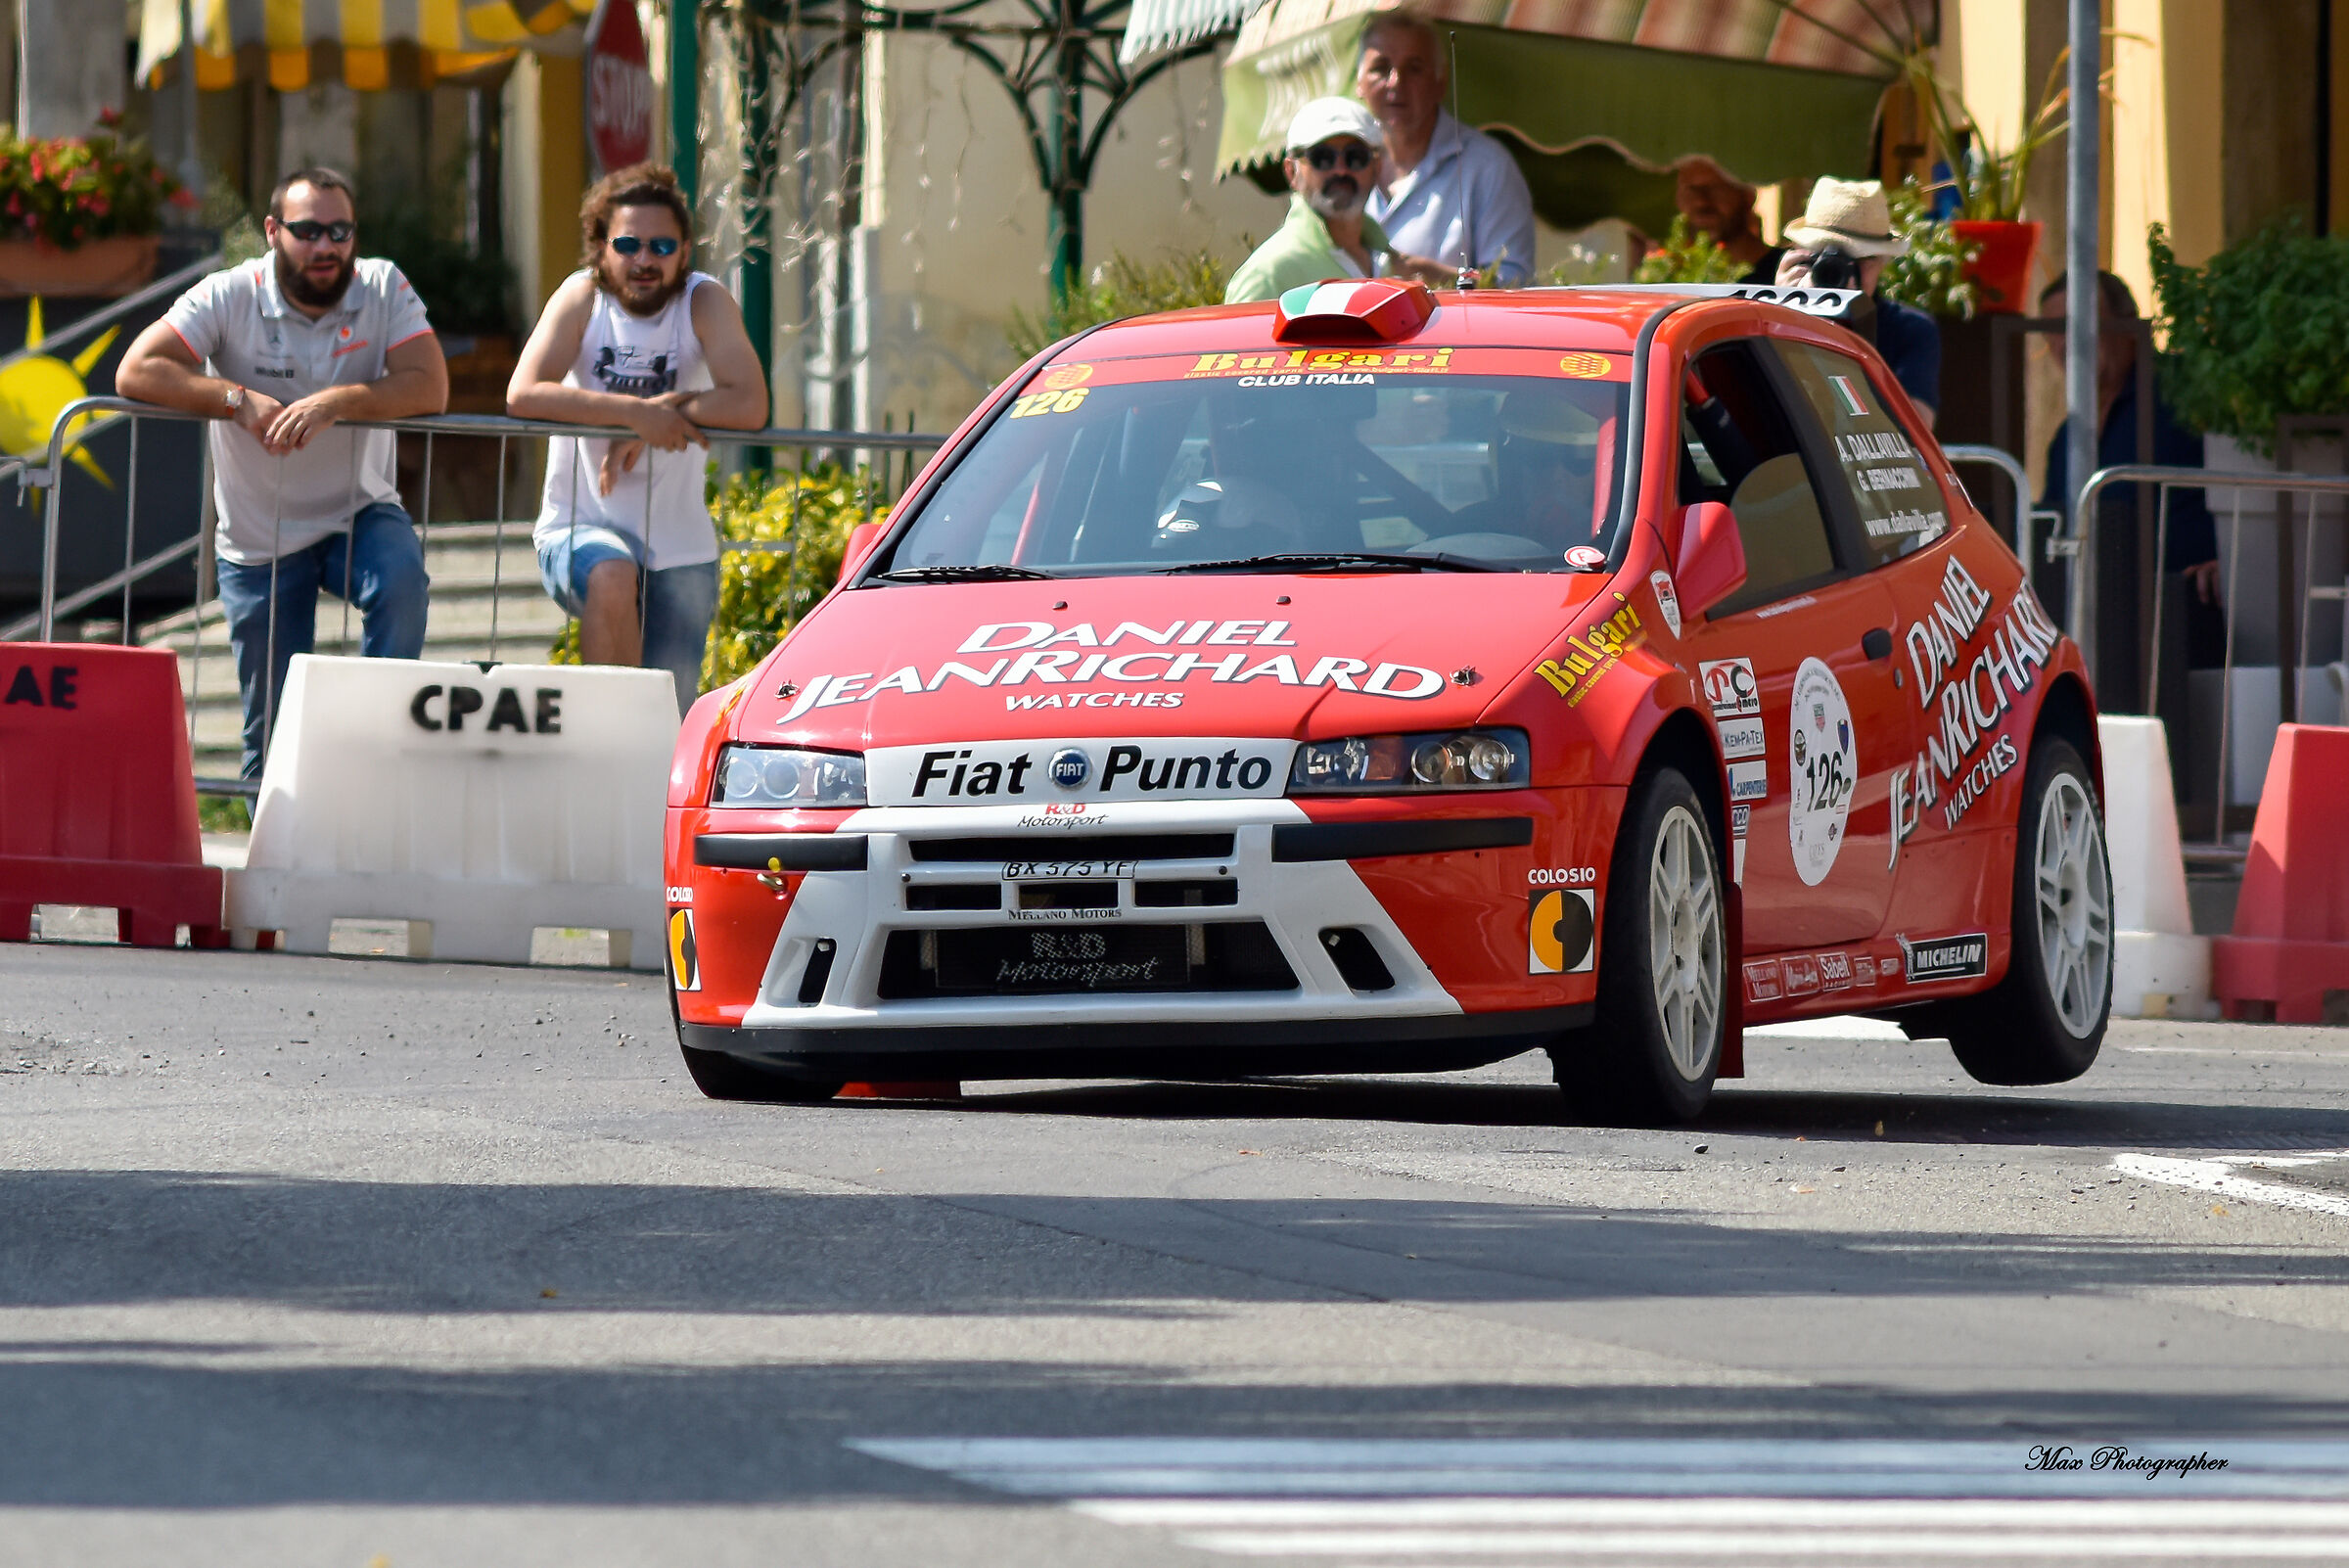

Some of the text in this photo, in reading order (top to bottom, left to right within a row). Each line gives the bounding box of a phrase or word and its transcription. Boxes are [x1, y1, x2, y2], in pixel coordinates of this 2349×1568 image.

[1191, 347, 1453, 370] Bulgari
[1237, 373, 1375, 388] CLUB ITALIA
[1009, 387, 1090, 419] 126
[1834, 435, 1854, 462] A.
[955, 620, 1299, 654] DANIEL
[1533, 591, 1642, 698] Bulgari
[1906, 553, 1993, 711] DANIEL
[0, 665, 78, 712] AE
[775, 650, 1448, 725] JEANRICHARD
[1005, 691, 1185, 712] WATCHES
[409, 684, 563, 735] CPAE
[910, 744, 1273, 798] Fiat FIAT Punto
[1806, 750, 1843, 813] 126
[1944, 733, 2018, 831] WATCHES
[1018, 813, 1110, 830] Motorsport
[1045, 802, 1086, 815] R&D
[1006, 860, 1036, 878] BX
[1045, 861, 1095, 877] 575
[1527, 866, 1596, 885] COLOSIO
[1071, 907, 1123, 919] MOTORS
[1916, 944, 1982, 969] MICHELIN
